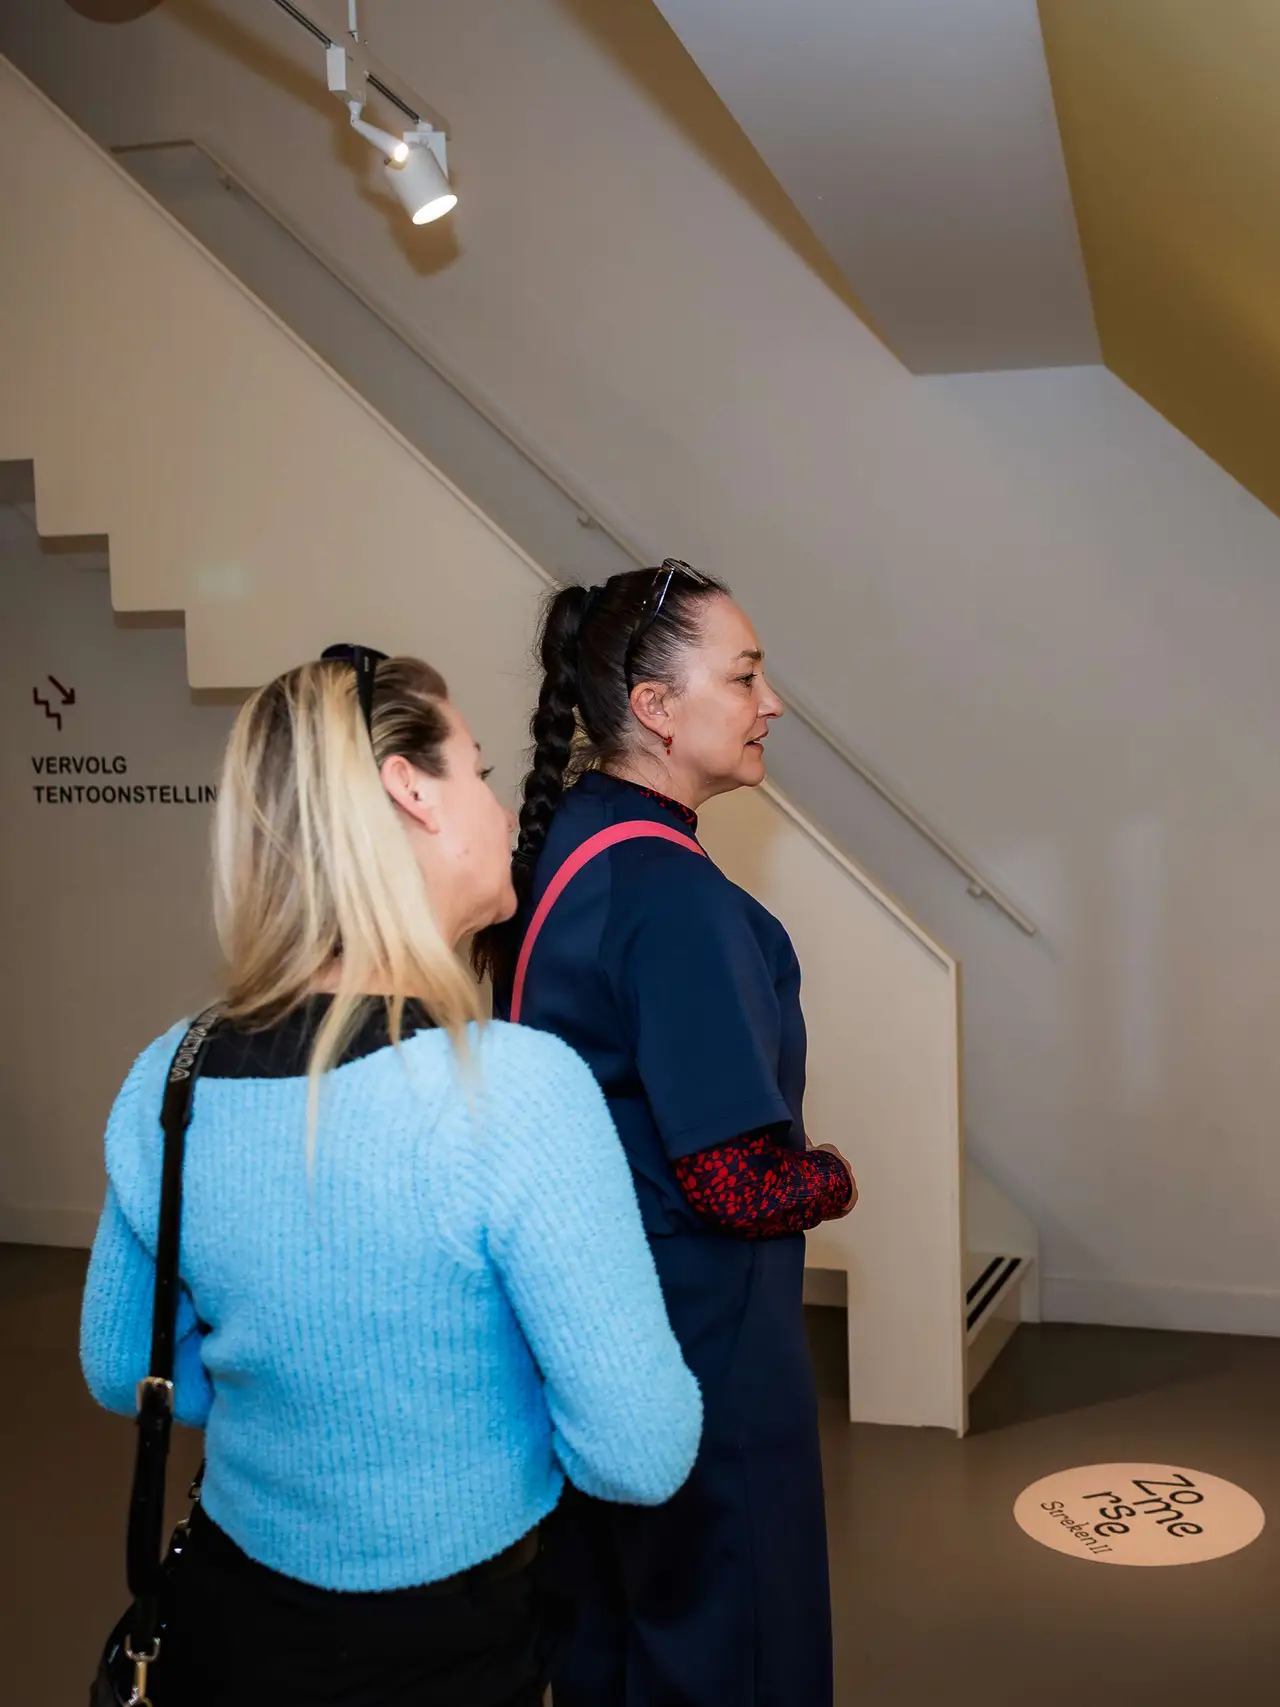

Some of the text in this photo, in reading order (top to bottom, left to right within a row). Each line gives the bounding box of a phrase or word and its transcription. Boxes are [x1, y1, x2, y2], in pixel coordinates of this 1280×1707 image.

[31, 755, 128, 775] VERVOLG
[33, 784, 217, 804] TENTOONSTELLIN
[1040, 1500, 1098, 1547] Streken
